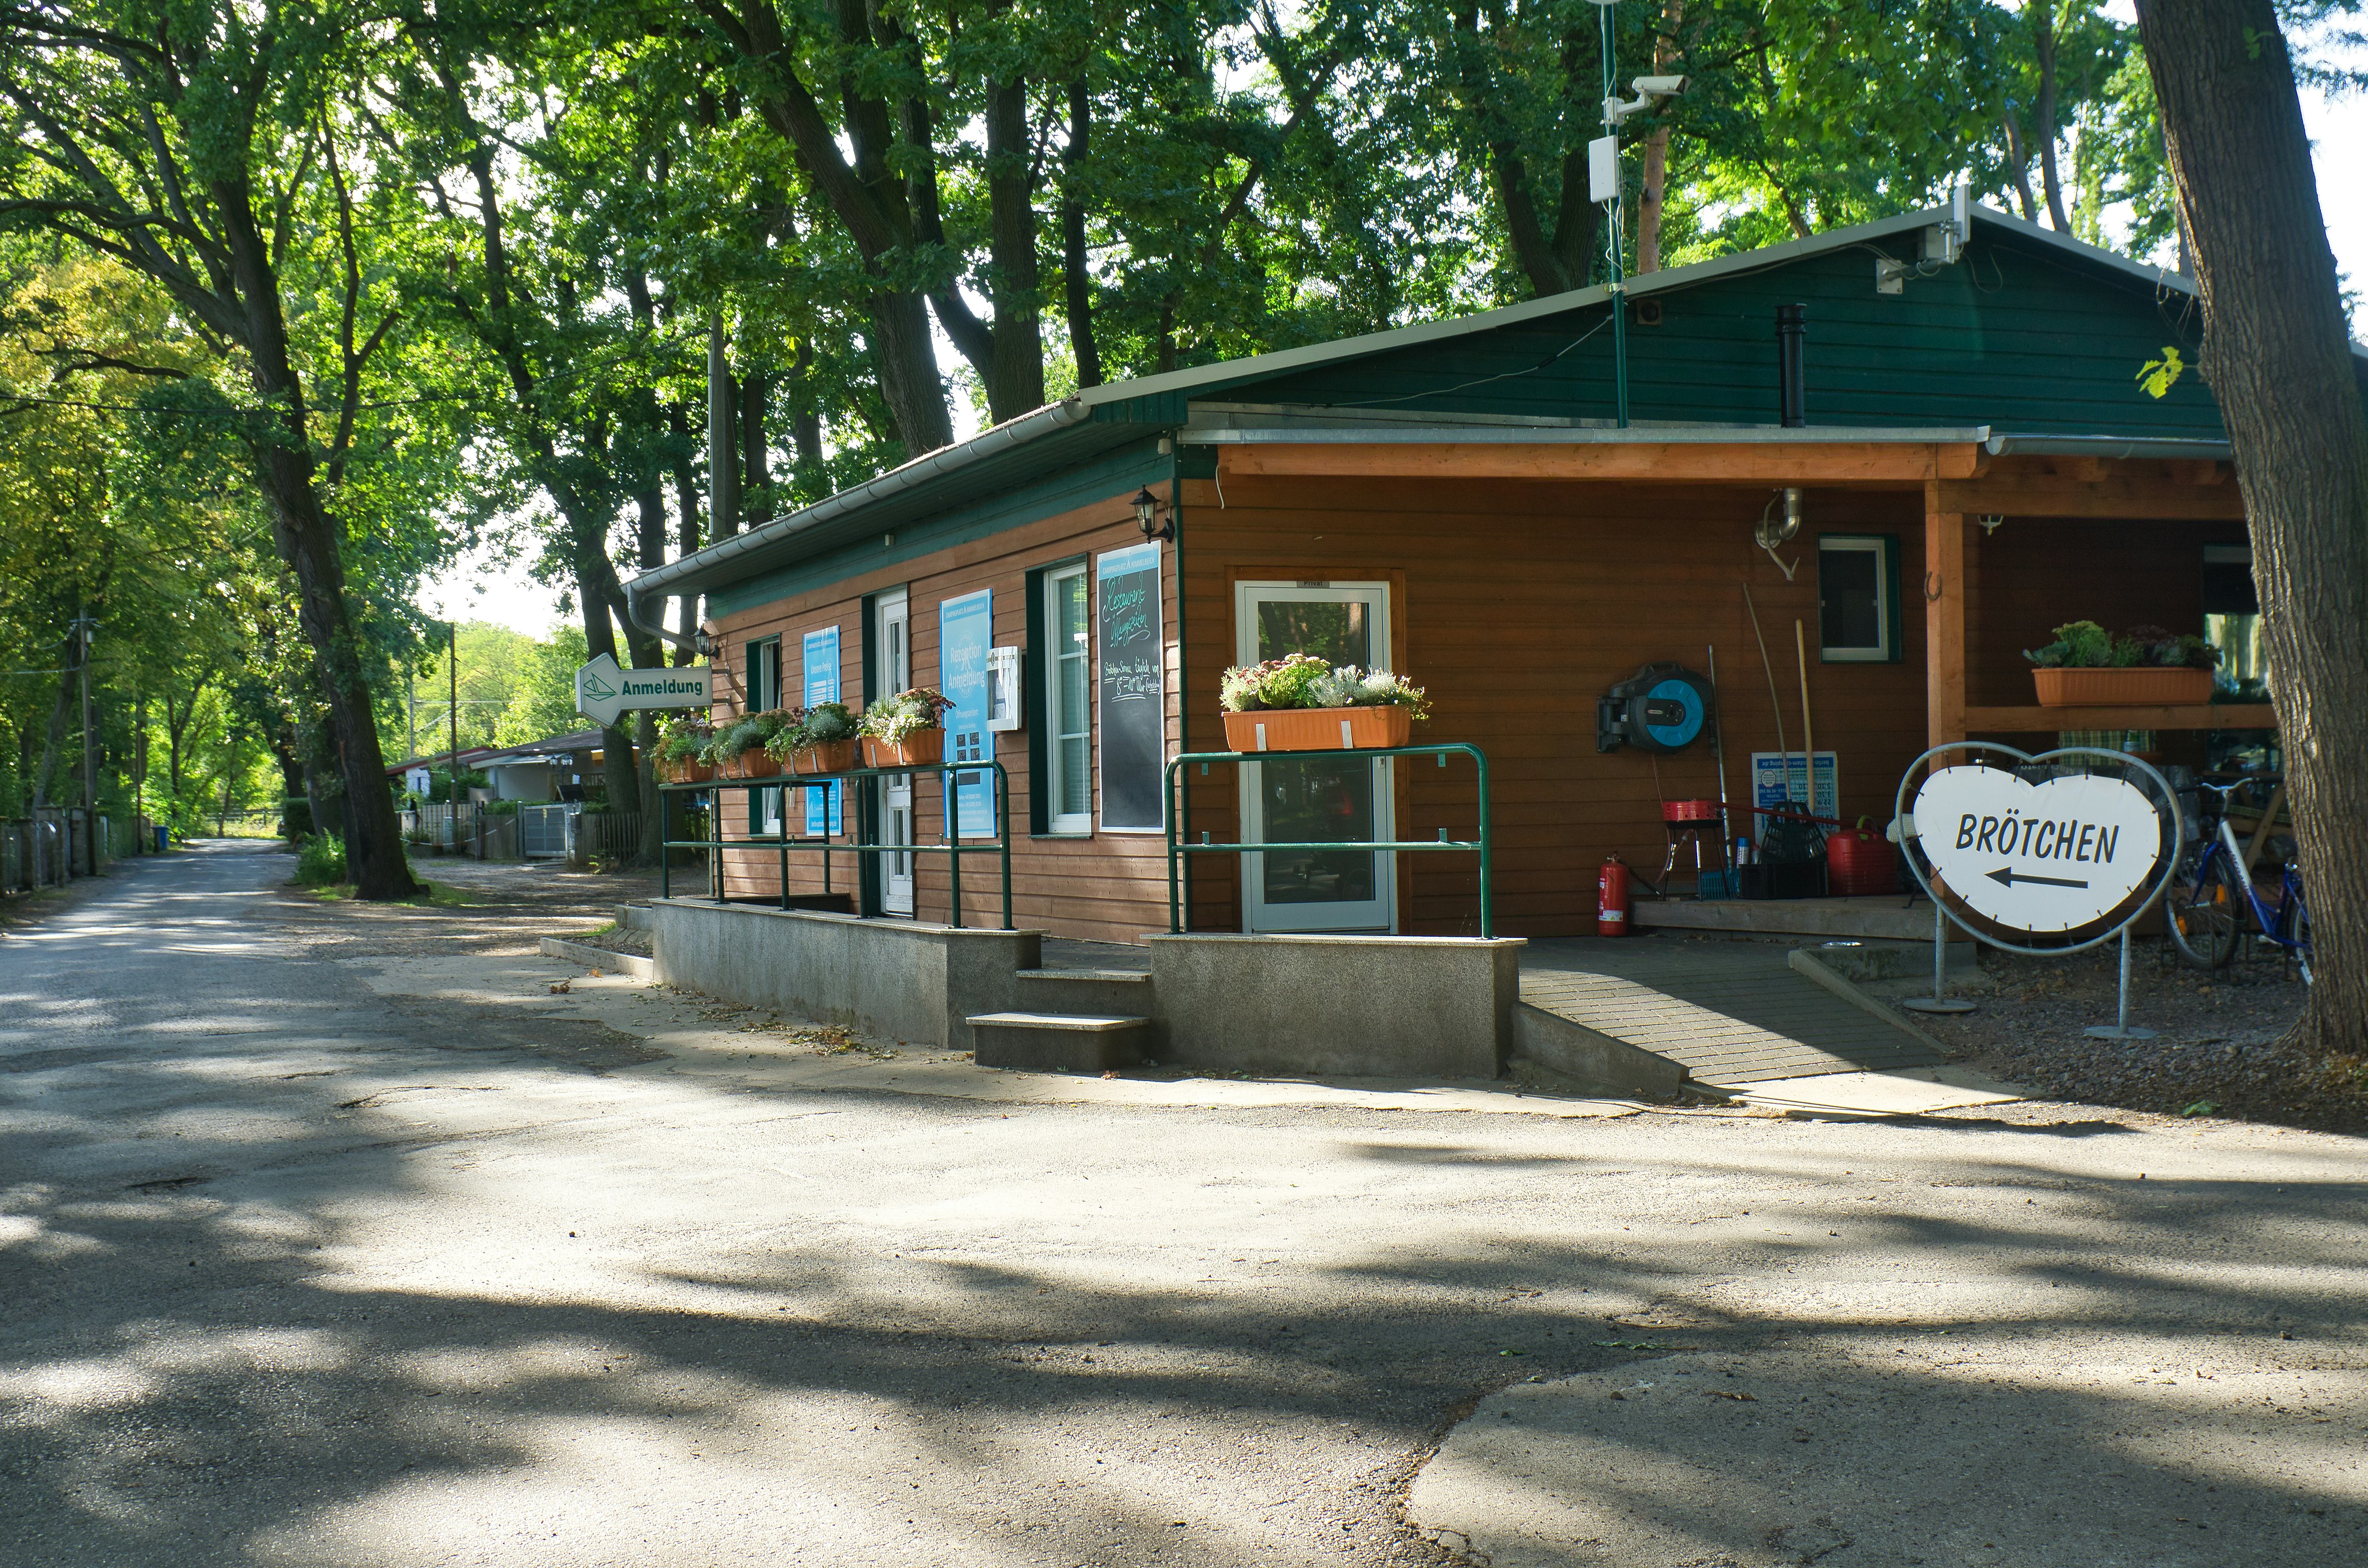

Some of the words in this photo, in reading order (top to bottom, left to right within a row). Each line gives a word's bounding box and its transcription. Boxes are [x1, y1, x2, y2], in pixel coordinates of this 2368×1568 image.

[1103, 563, 1126, 574] CAMPINGPLATZ
[1131, 556, 1155, 568] HIMMELREICH
[1105, 571, 1146, 612] Restaurant
[622, 678, 702, 696] Anmeldung
[948, 668, 985, 689] Anmeldung
[1956, 808, 2120, 863] BRÖTCHEN
